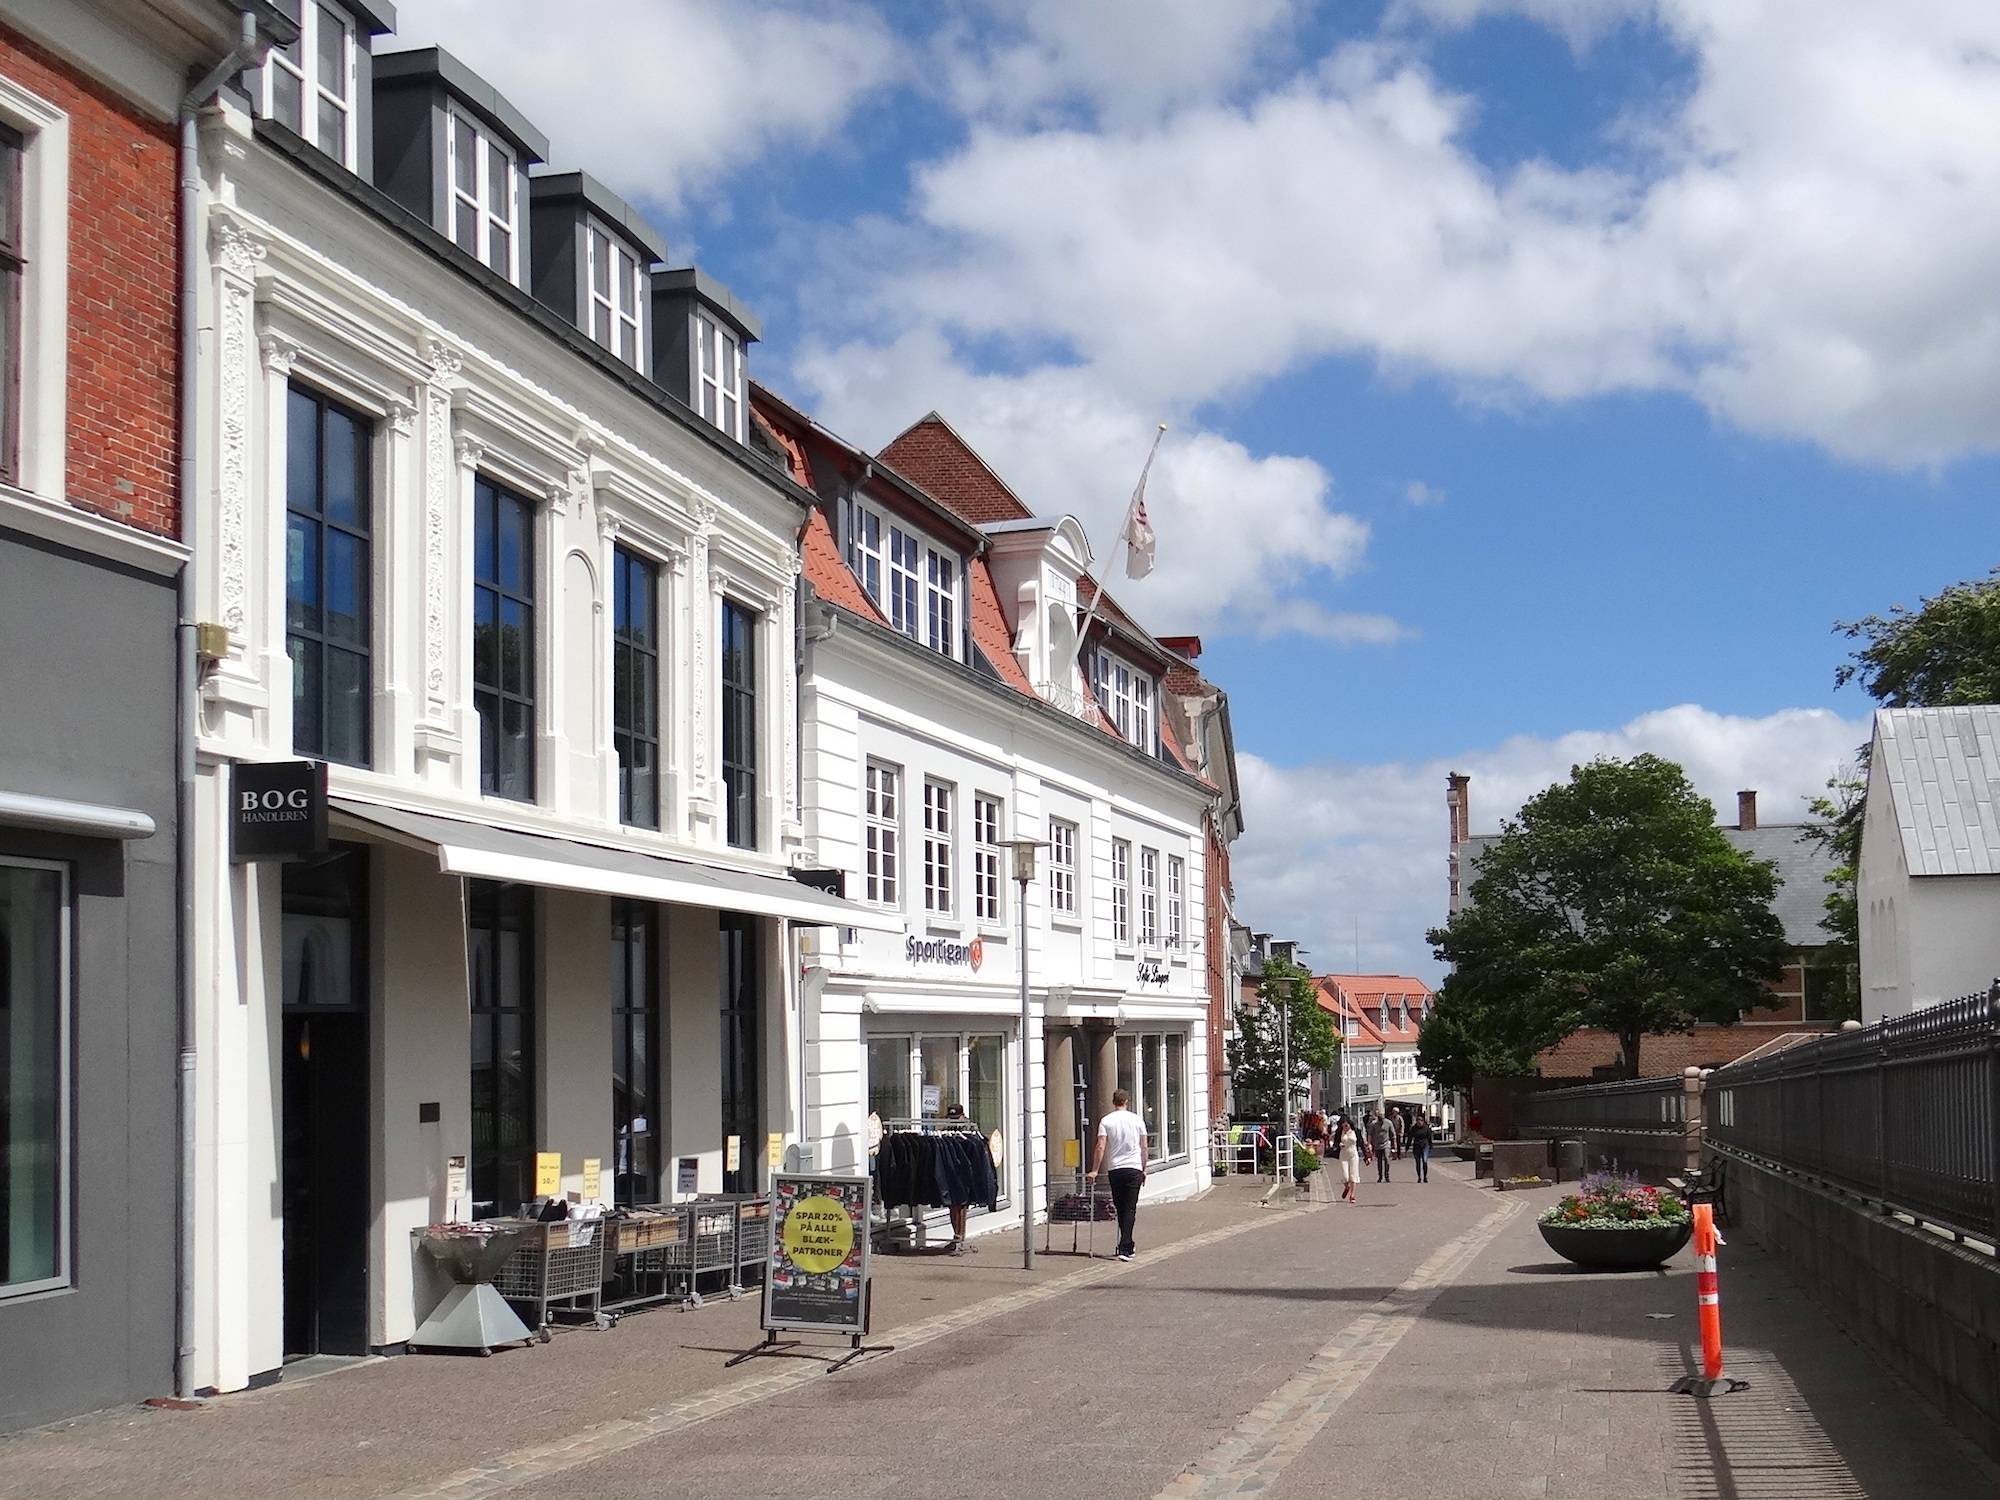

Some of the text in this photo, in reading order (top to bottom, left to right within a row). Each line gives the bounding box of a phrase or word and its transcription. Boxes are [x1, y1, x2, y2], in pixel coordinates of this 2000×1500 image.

[241, 788, 308, 810] BOG
[242, 811, 308, 822] HANDLEREN
[907, 935, 970, 965] Sportigan
[795, 1211, 843, 1222] SPAR 20%
[800, 1222, 837, 1233] PÅ ALLE
[802, 1235, 834, 1244] BLÆK-
[792, 1246, 843, 1257] PATRONER
